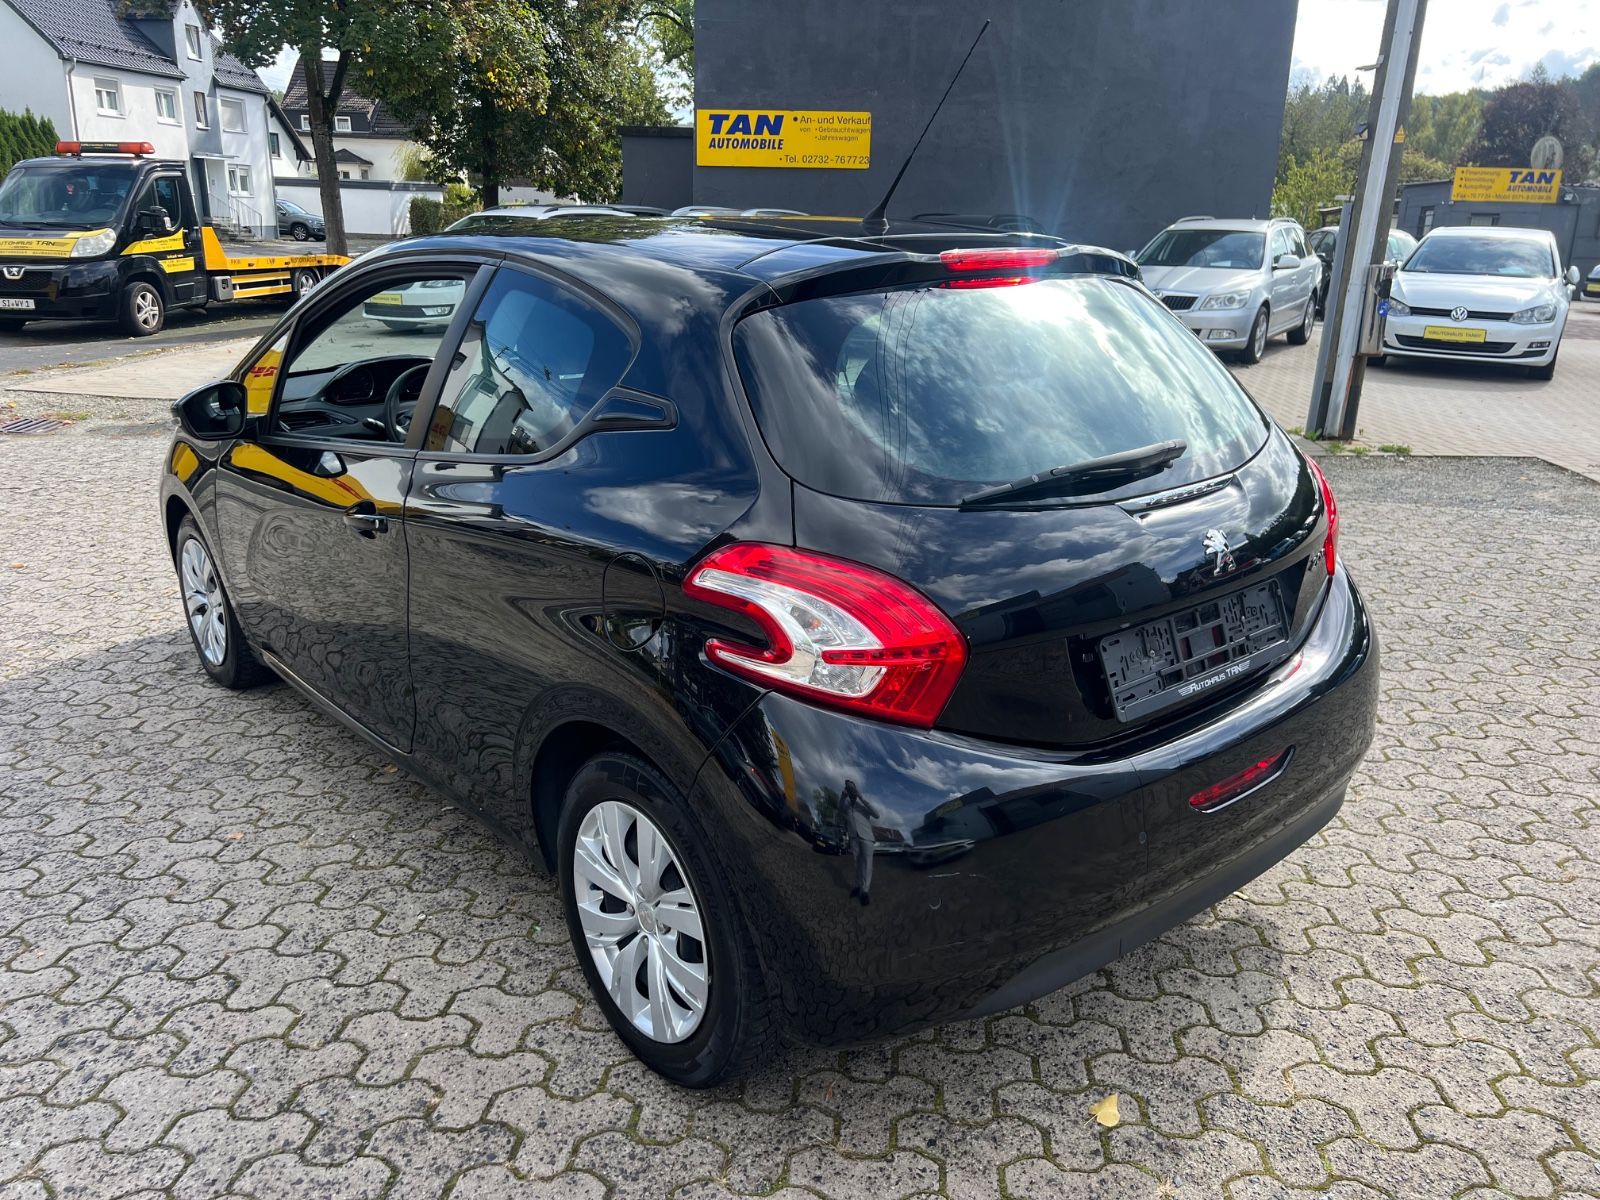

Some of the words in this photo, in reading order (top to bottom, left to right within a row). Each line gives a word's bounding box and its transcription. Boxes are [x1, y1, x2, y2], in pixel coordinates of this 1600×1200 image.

[709, 114, 784, 136] TAN
[817, 116, 835, 125] und
[837, 116, 871, 125] Verkauf
[708, 137, 784, 150] AUTOMOBILE
[784, 154, 799, 163] Tel.
[1510, 171, 1556, 184] TAN
[1190, 672, 1226, 692] AUTOHAUS
[1225, 665, 1243, 677] TAN
